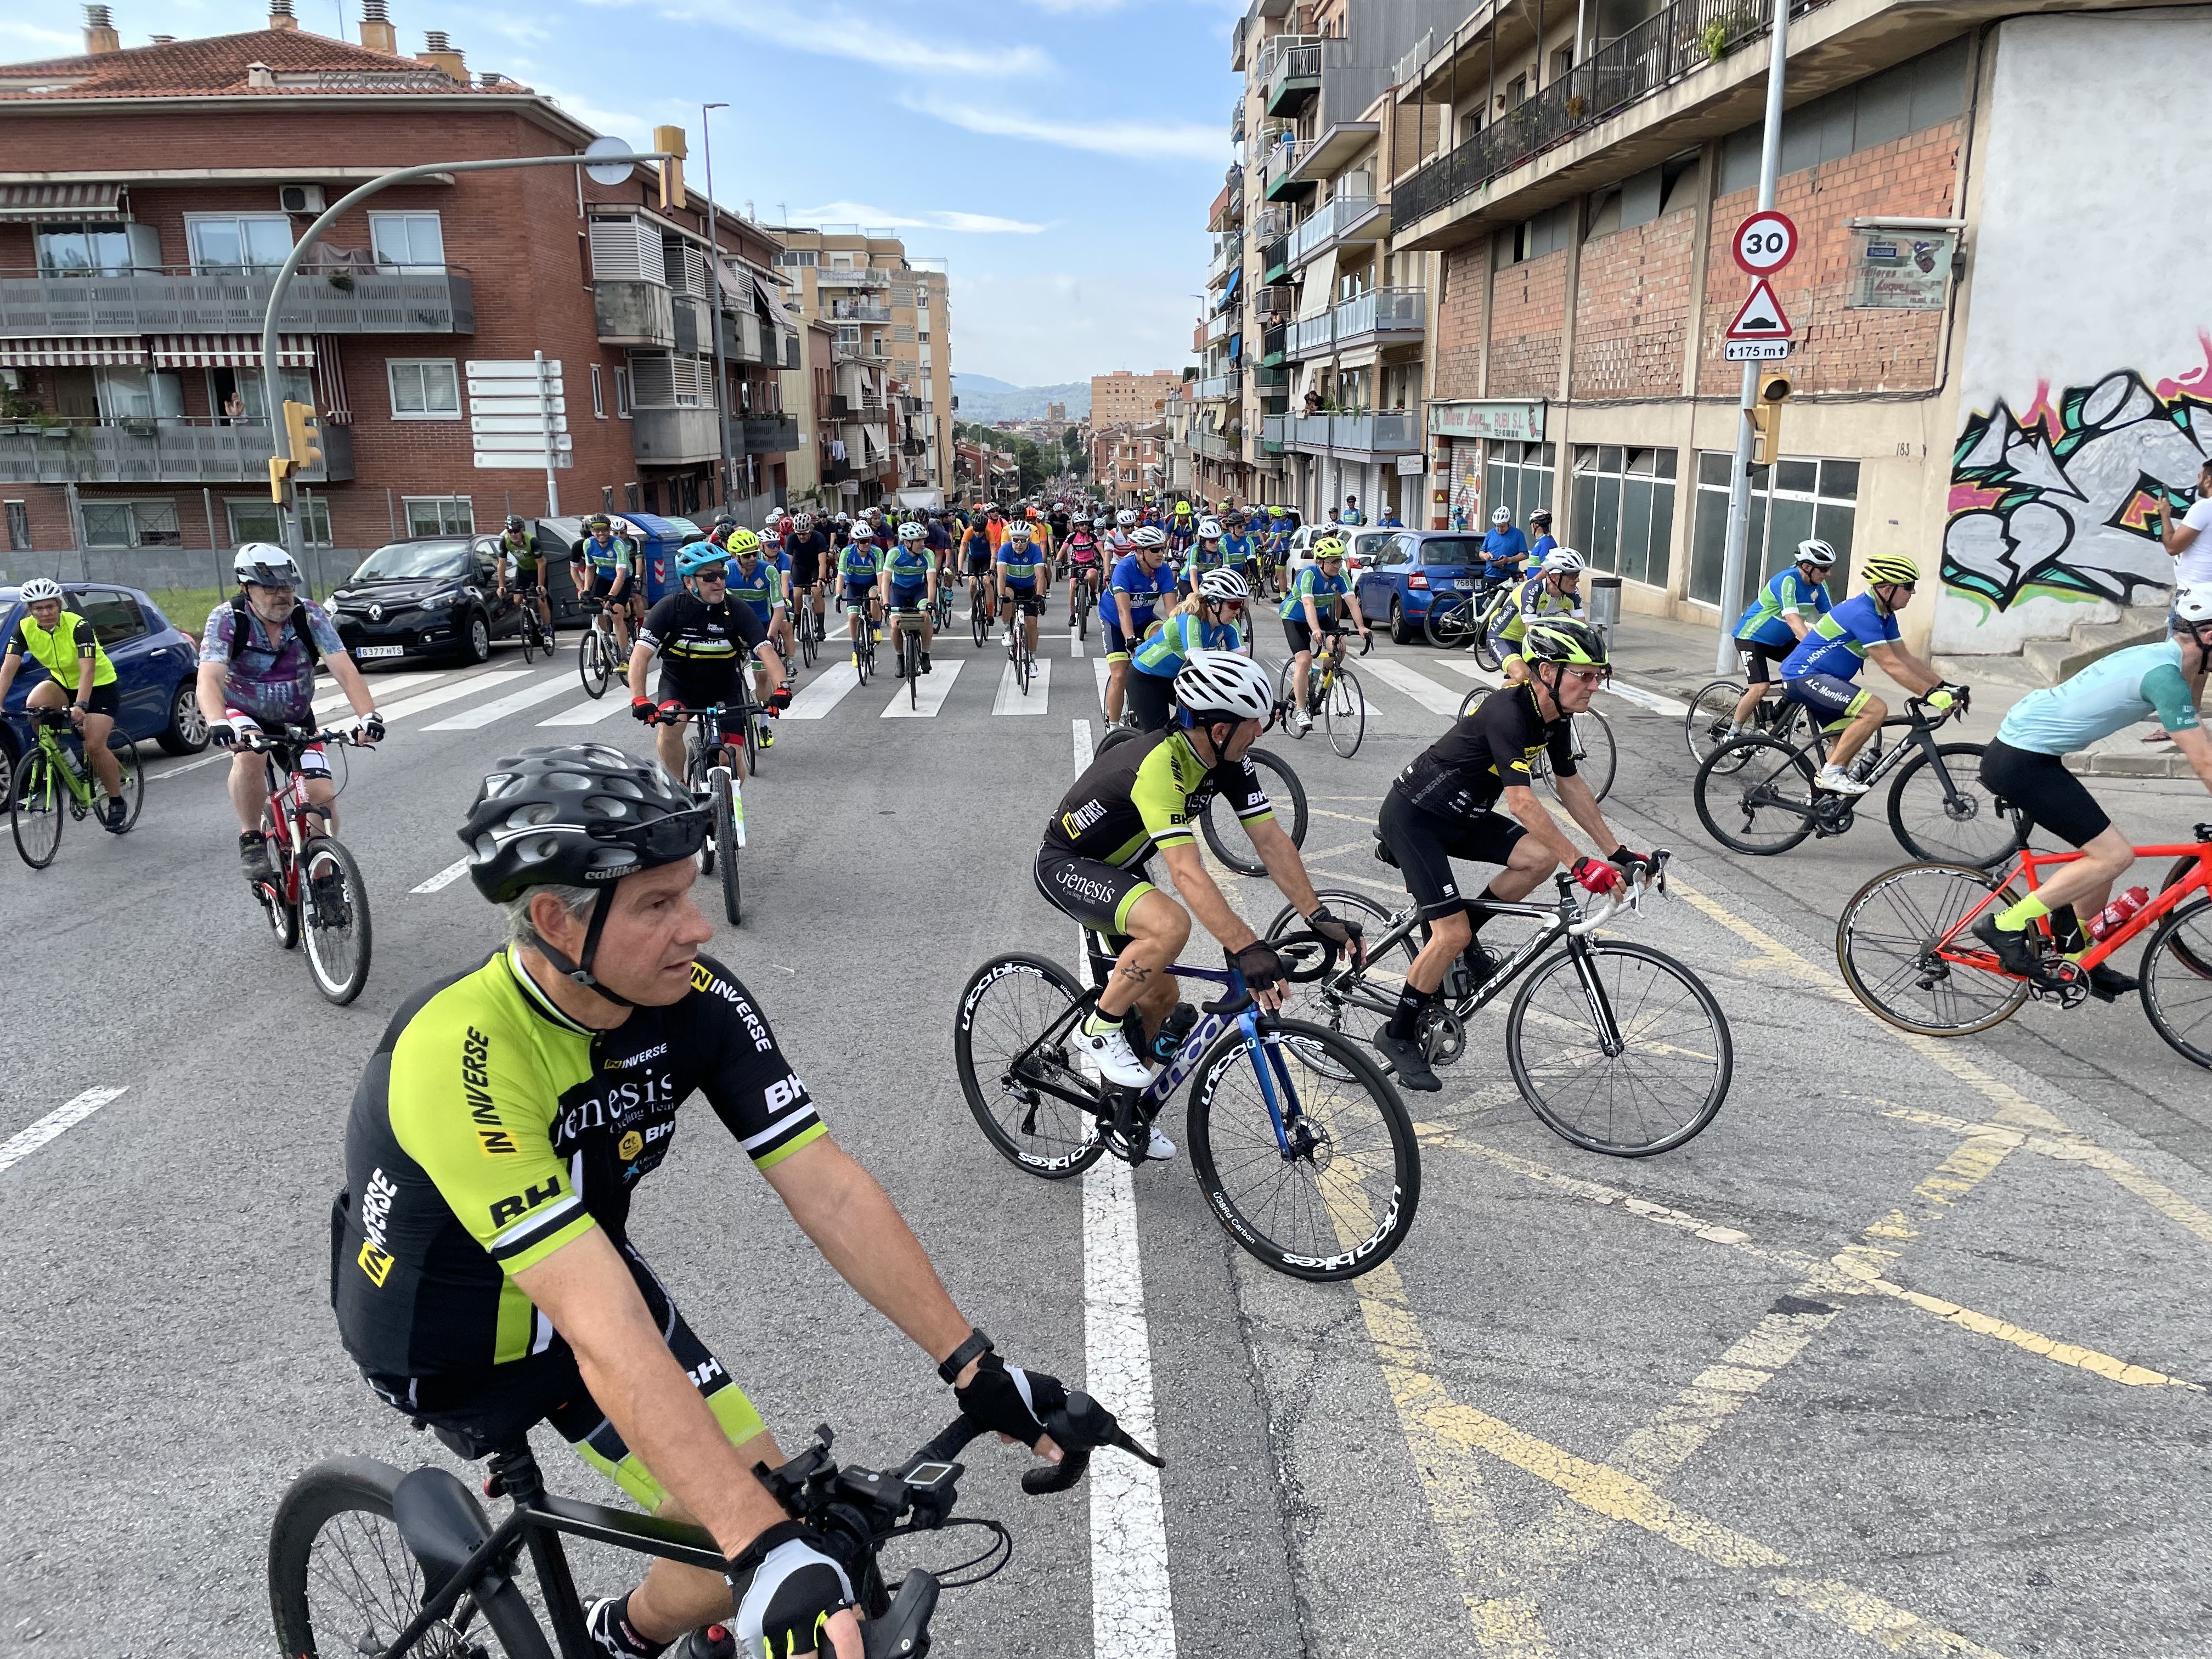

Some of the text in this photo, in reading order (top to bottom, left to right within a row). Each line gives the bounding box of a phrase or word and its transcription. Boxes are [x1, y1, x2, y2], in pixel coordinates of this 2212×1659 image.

[1746, 233, 1783, 255] 30
[1860, 267, 1897, 277] Talleres
[1738, 346, 1776, 357] 175 m
[1443, 408, 1464, 426] Talleres
[1494, 412, 1510, 429] RUBI
[1513, 413, 1525, 430] S.L.
[1896, 443, 1910, 456] 183
[386, 646, 402, 654] HTS
[1805, 679, 1820, 691] A.C.
[1247, 791, 1268, 806] BH
[584, 864, 642, 880] catlike
[1056, 864, 1115, 904] Genesis
[1062, 886, 1096, 906] Cycling Team
[1455, 932, 1550, 1017] ORBEA
[1060, 984, 1077, 1003] arbon
[709, 979, 772, 1052] INVERSE
[621, 1042, 668, 1069] INVERSE
[462, 1025, 518, 1154] IN INVERSE
[764, 1071, 808, 1114] BH
[646, 1121, 675, 1143] BH
[489, 1175, 561, 1230] BH
[1231, 1218, 1255, 1244] Carbon
